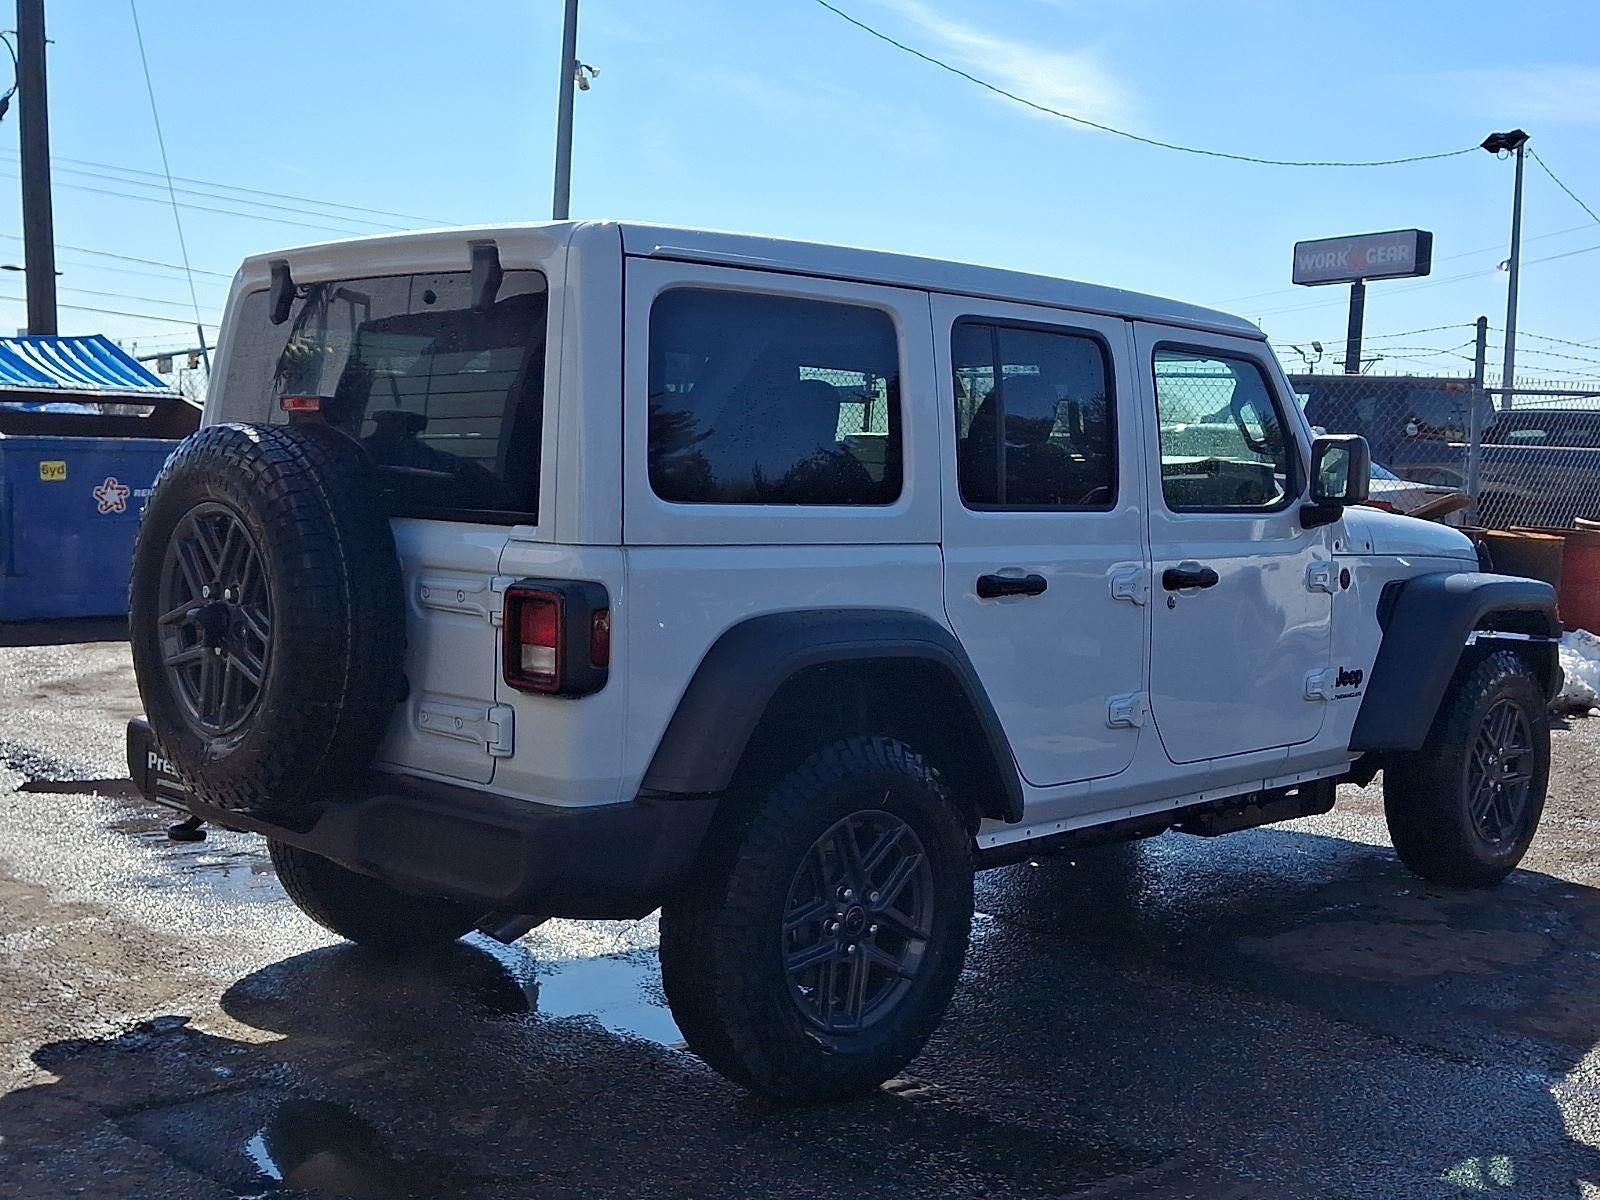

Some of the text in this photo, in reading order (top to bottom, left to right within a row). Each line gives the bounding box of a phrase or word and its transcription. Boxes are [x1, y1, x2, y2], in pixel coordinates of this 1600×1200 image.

[1299, 250, 1349, 271] WORK
[1366, 244, 1410, 264] GEAR
[1335, 666, 1363, 688] Jeep
